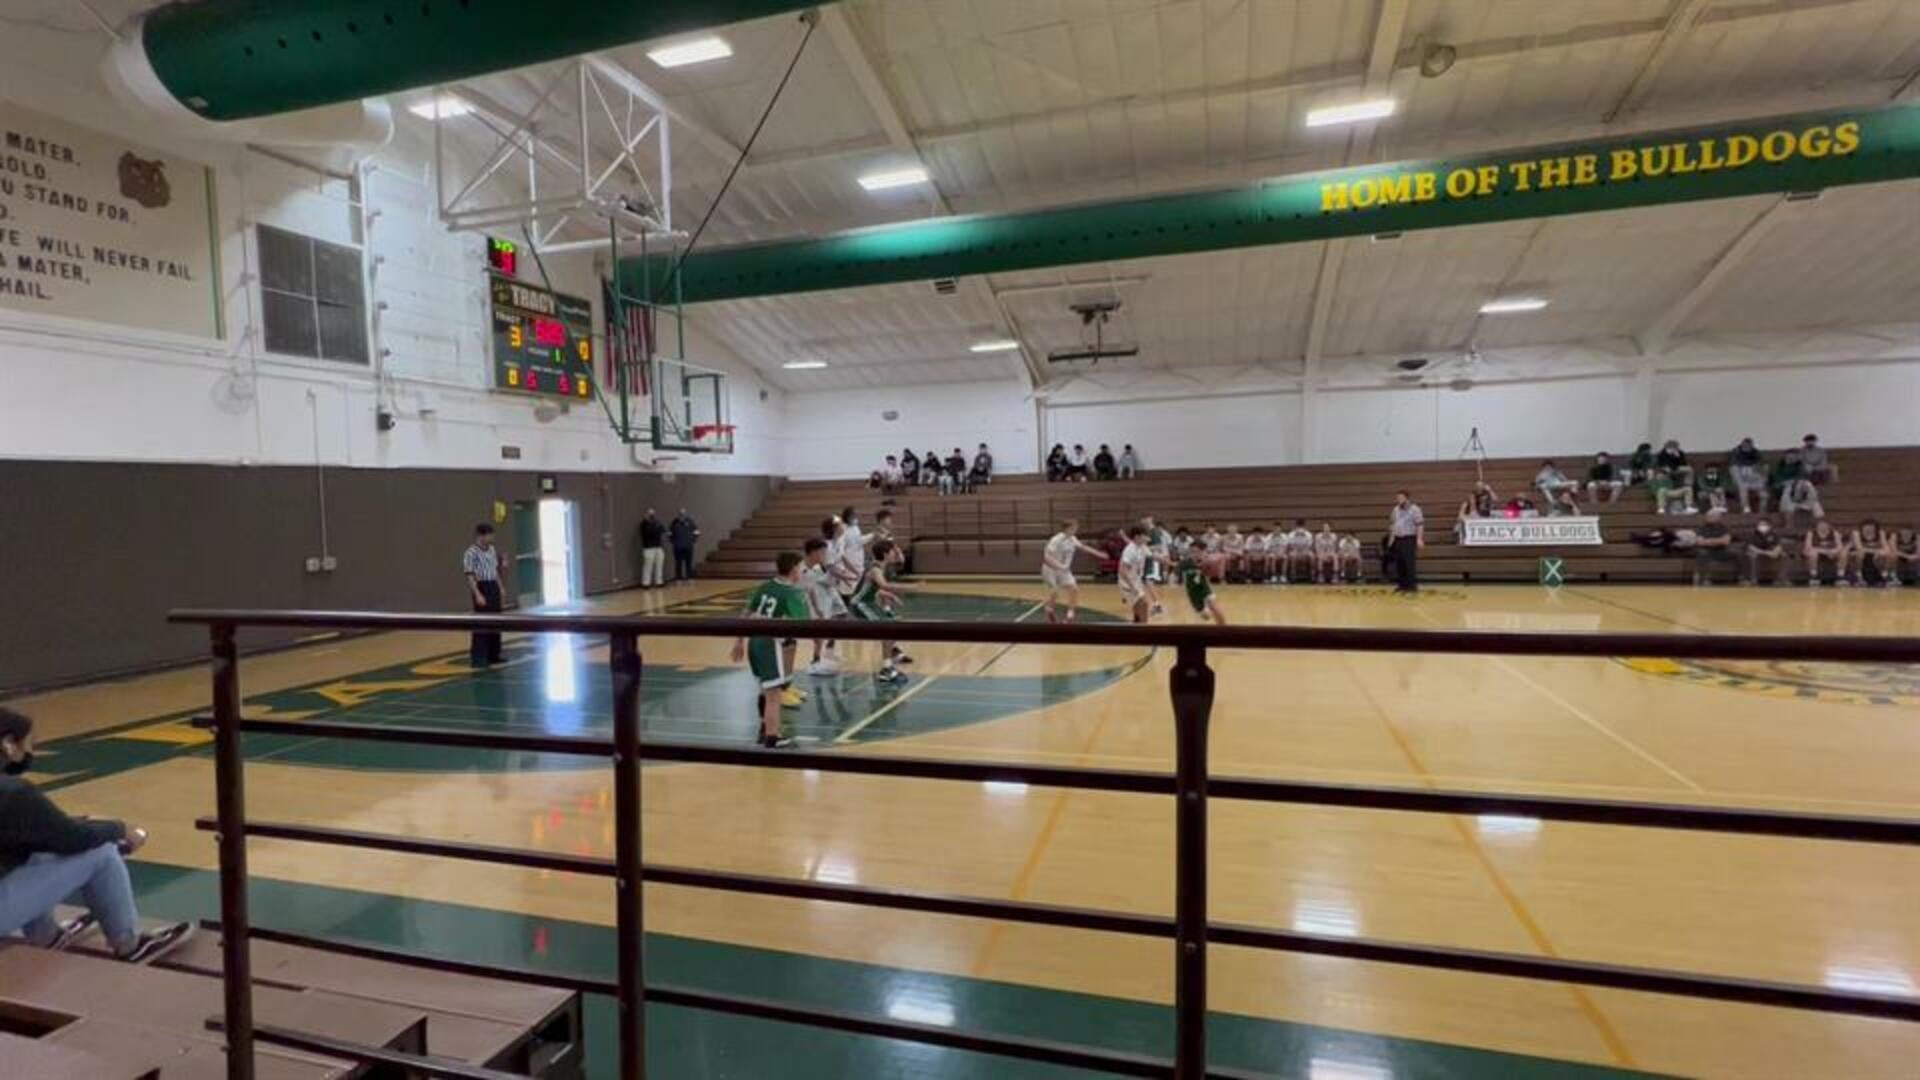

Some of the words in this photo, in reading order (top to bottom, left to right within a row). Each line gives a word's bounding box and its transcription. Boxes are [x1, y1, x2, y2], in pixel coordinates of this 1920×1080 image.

[6, 131, 82, 166] MATER.
[1321, 171, 1436, 211] HOME
[1446, 165, 1500, 198] OF
[1509, 154, 1598, 191] THE
[1610, 121, 1860, 180] BULLDOGS
[24, 183, 88, 212] STAND
[37, 235, 86, 259] WILL
[93, 247, 150, 272] NEVER
[18, 254, 91, 284] MATER.
[511, 284, 555, 314] TRACY
[510, 324, 522, 348] 3
[1471, 526, 1516, 538] TRACY
[1521, 525, 1596, 538] BULLDOGS
